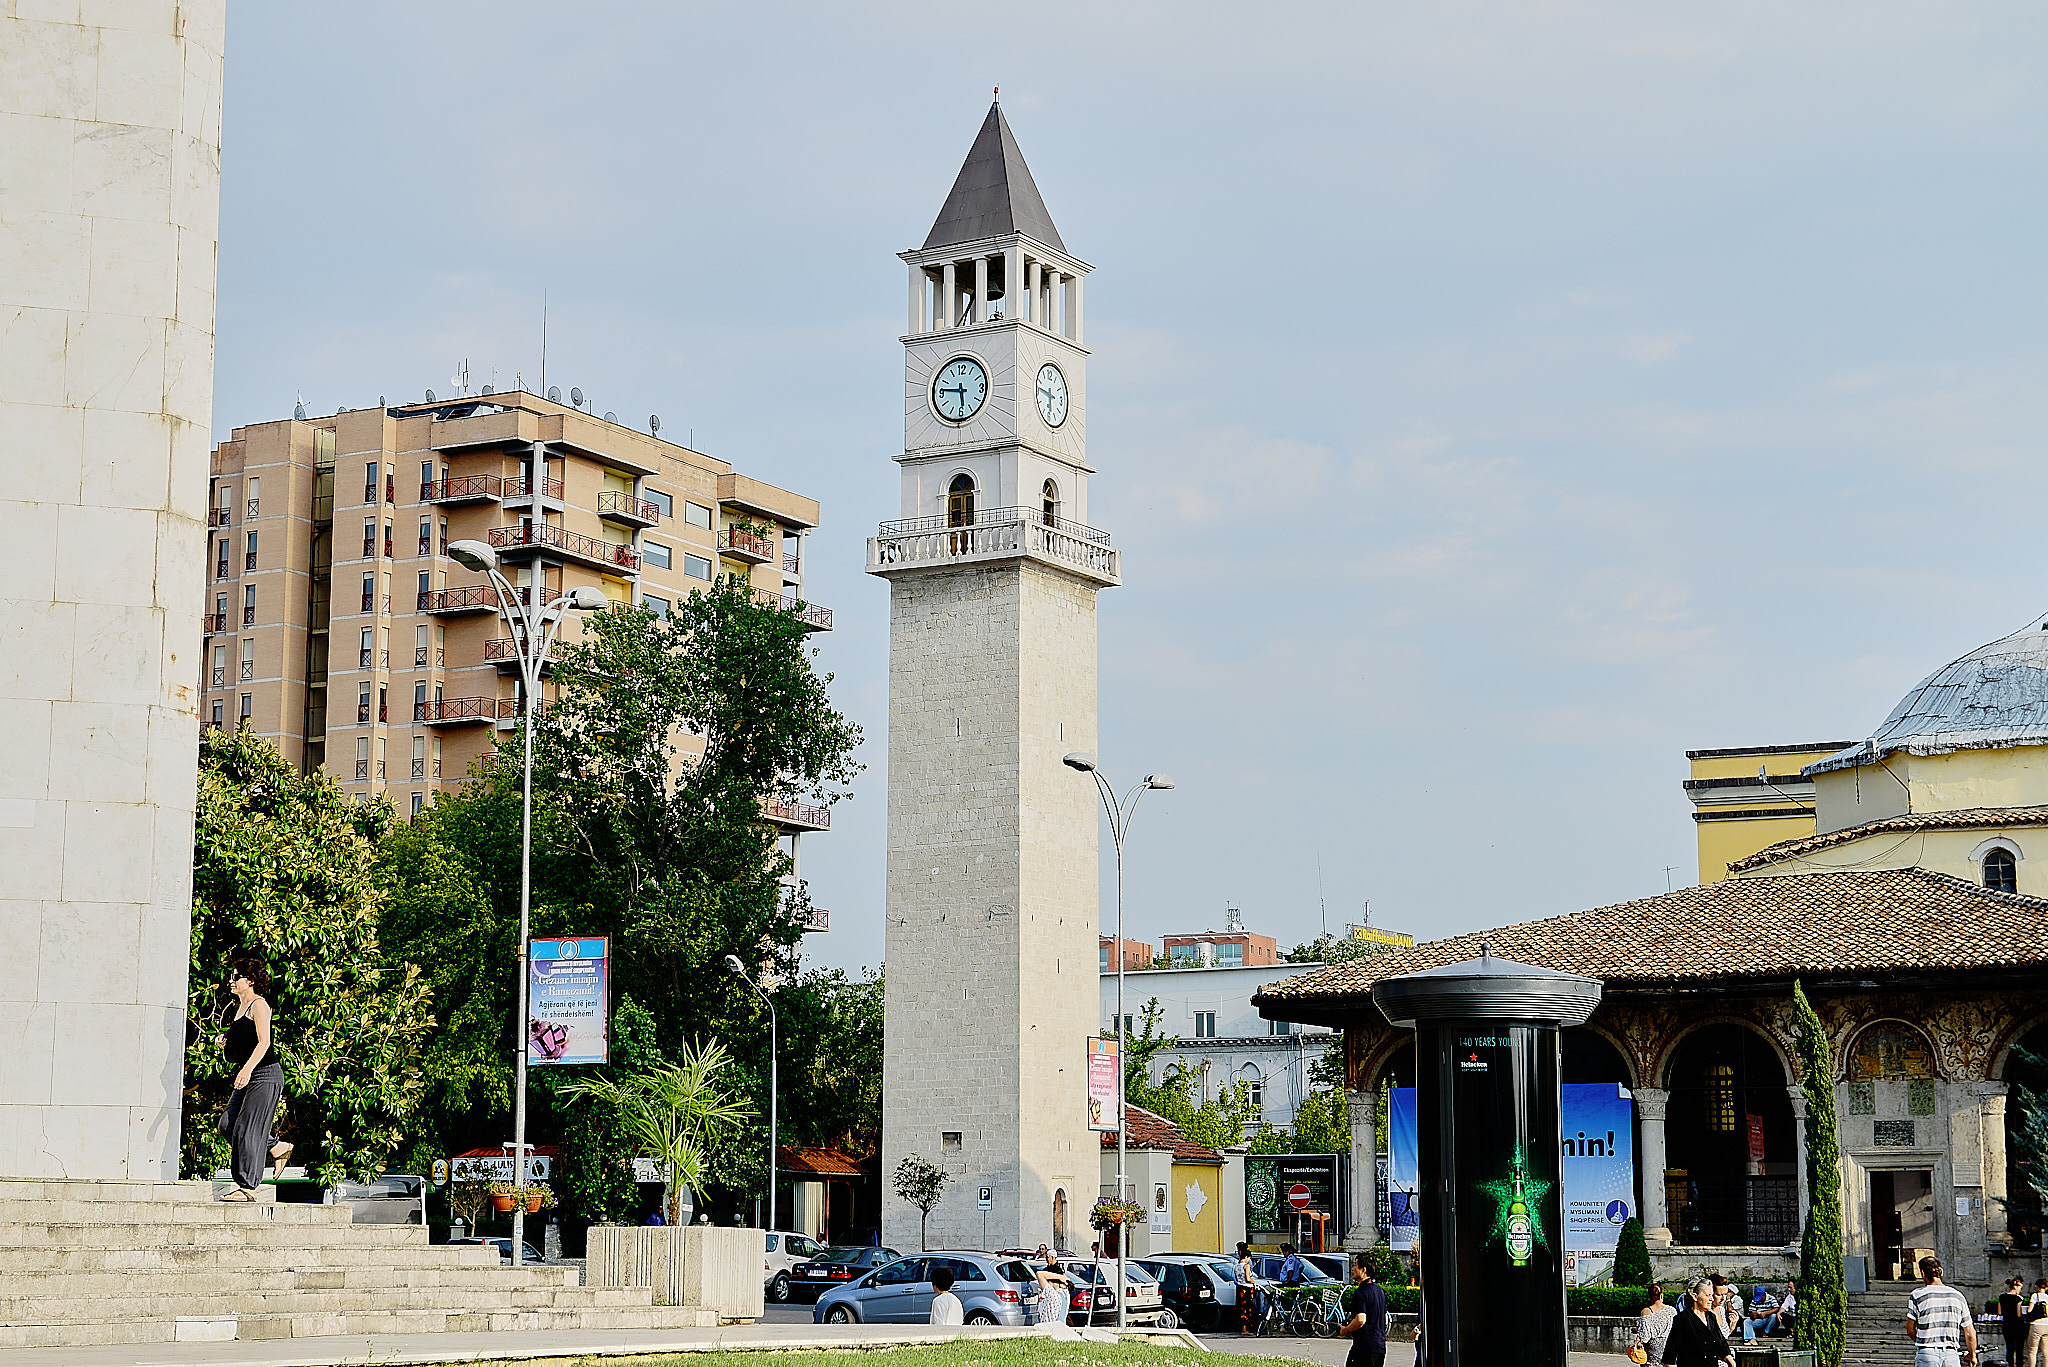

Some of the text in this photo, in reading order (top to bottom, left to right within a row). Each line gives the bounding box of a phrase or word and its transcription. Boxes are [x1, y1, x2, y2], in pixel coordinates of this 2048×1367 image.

[958, 364, 966, 375] 12
[939, 388, 945, 399] 9
[979, 383, 985, 393] 3
[958, 406, 963, 417] 6
[1474, 1036, 1497, 1047] YEARS
[981, 1188, 989, 1200] P
